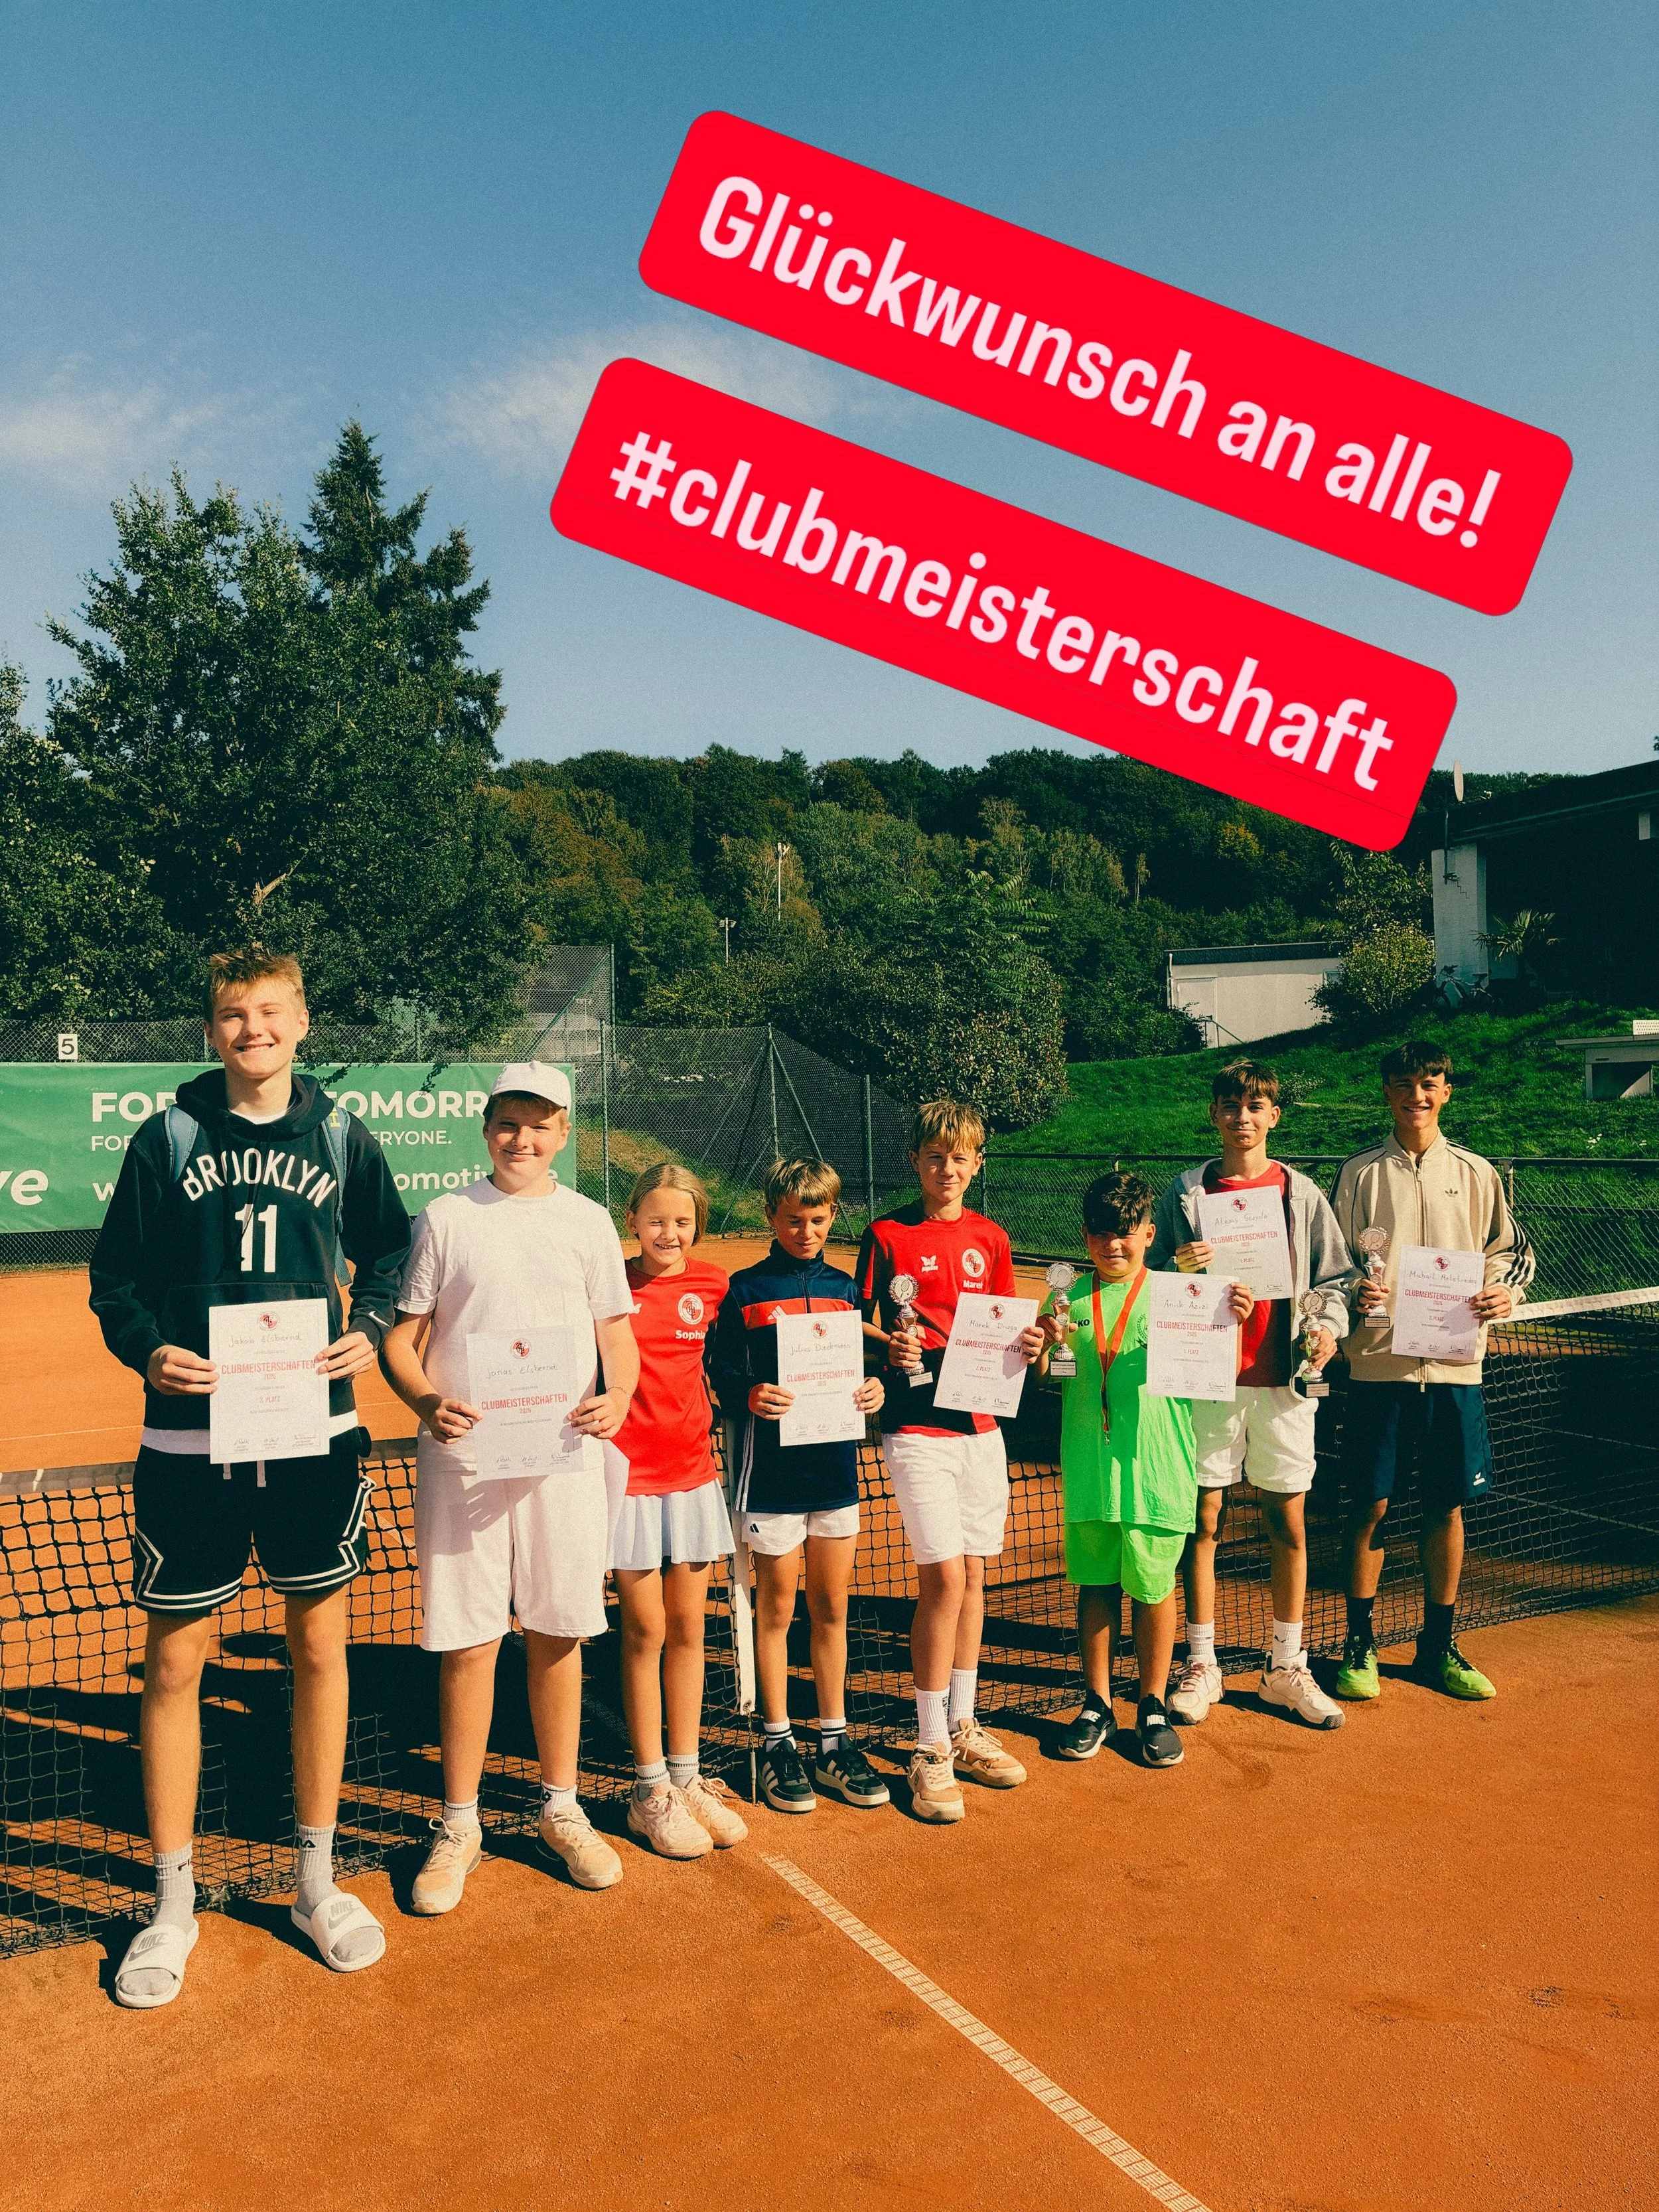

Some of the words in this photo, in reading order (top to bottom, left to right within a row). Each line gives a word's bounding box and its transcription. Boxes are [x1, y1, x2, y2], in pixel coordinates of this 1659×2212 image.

[61, 1038, 75, 1055] 5
[182, 1147, 337, 1208] BROOKLYN
[234, 1203, 277, 1273] 11
[1210, 1230, 1278, 1244] CLUBMEISTERSCHAFTEN
[1156, 1321, 1228, 1333] CLUBMEISTERSCHAFTEN
[956, 1339, 1022, 1353] CLUBMEISTERSCHAFTEN
[222, 1359, 317, 1374] CLUBMEISTERSCHAFTEN
[786, 1369, 855, 1382] CLUBMEISTERSCHAFTEN
[481, 1393, 568, 1411] CLUBMEISTERSCHAFTEN
[1079, 1710, 1102, 1723] NIKE
[1146, 1714, 1167, 1727] NIKE
[330, 1900, 354, 1918] NIKE
[137, 1932, 168, 1951] NIKE
